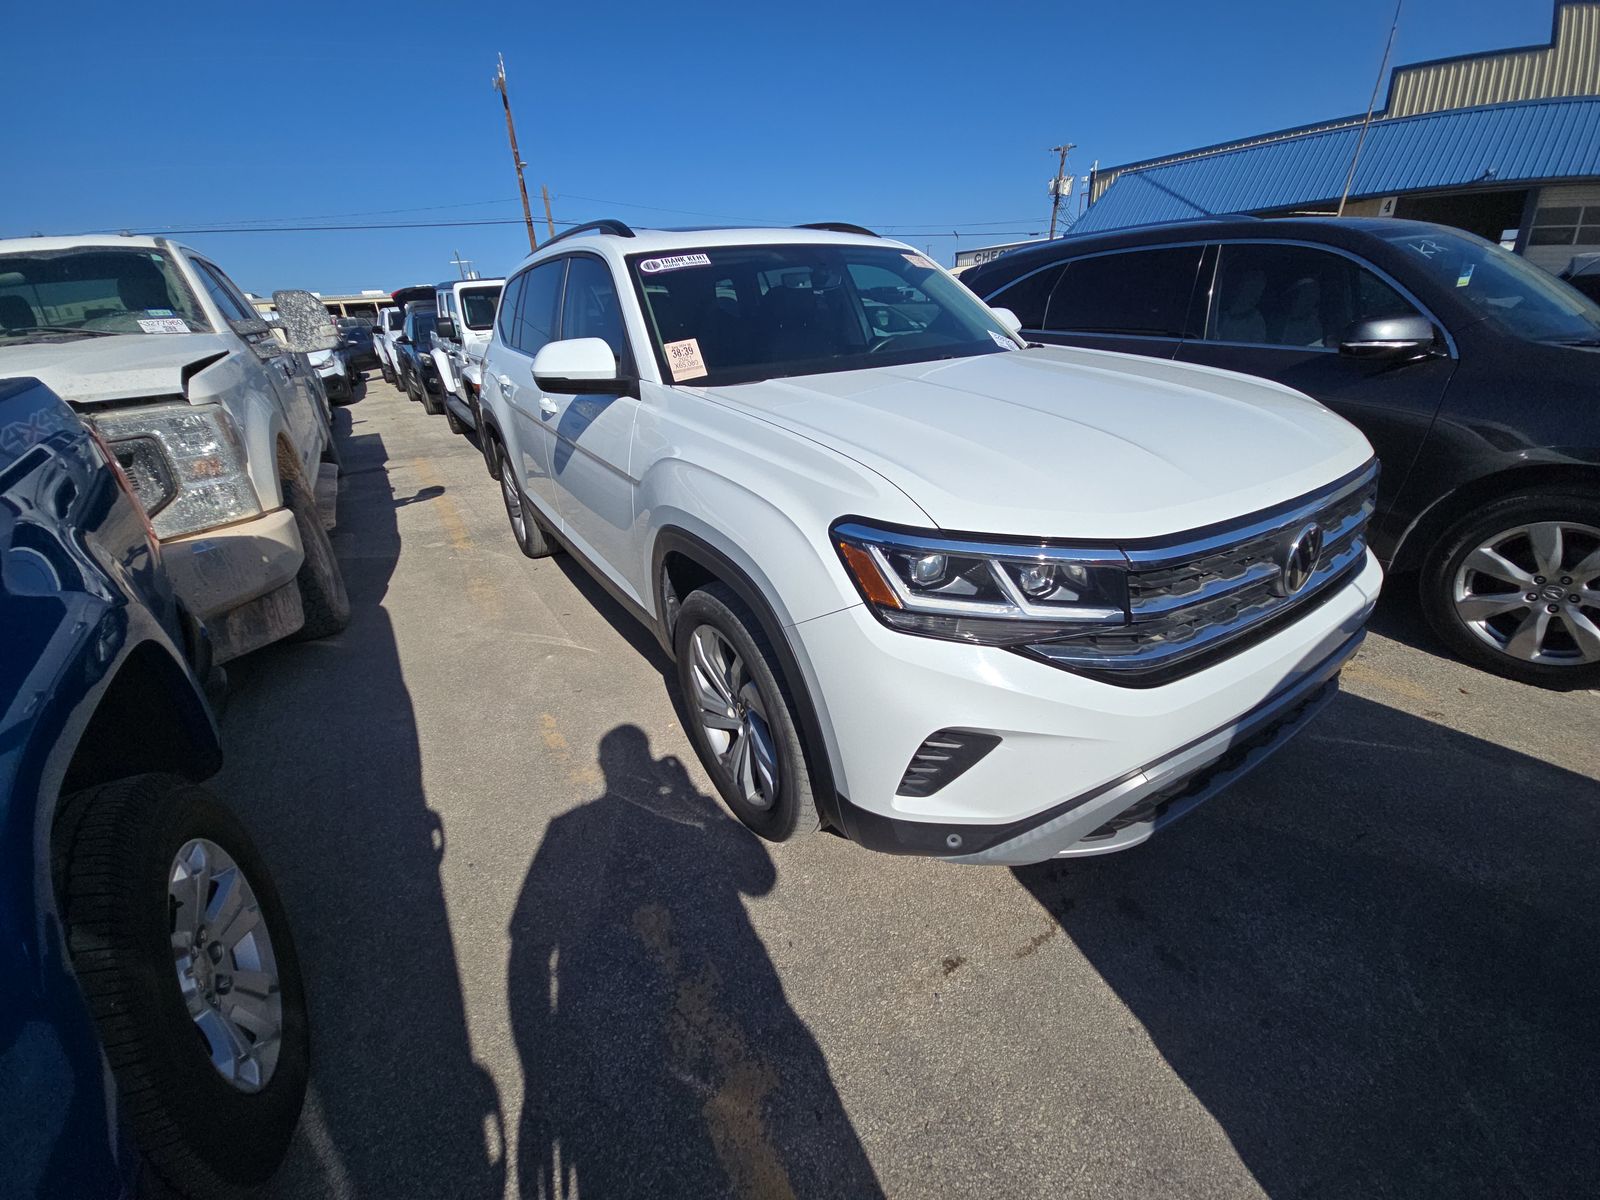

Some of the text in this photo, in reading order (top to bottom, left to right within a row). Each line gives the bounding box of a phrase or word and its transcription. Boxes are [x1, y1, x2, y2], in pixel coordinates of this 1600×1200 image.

[1384, 200, 1393, 213] 4
[661, 254, 706, 265] FRANK KENT
[671, 346, 693, 358] 38:39
